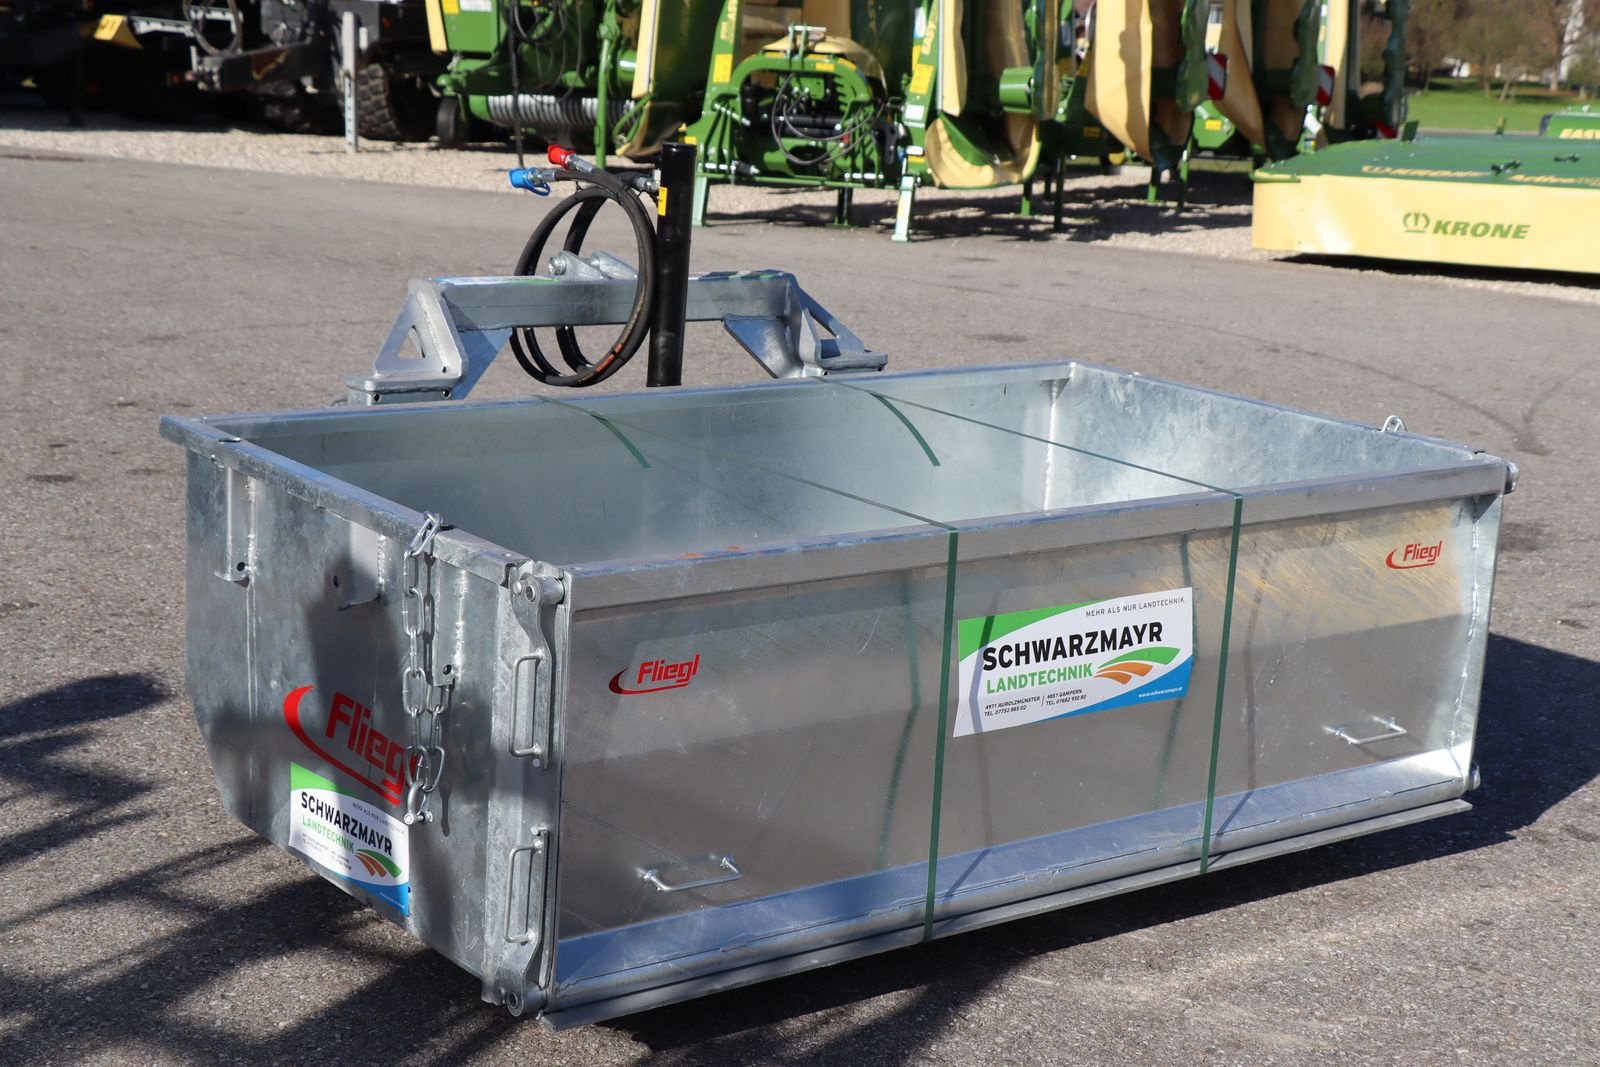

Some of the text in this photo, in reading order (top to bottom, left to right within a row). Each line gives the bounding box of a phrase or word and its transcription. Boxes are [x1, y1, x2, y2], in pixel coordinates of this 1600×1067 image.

[1432, 219, 1530, 240] KRONE
[1403, 540, 1443, 563] Fliegl
[1085, 609, 1105, 617] MEHR
[1107, 606, 1121, 614] ALS
[1122, 604, 1137, 612] NUR
[982, 621, 1163, 671] SCHWARZMAYR
[637, 654, 700, 685] Fliegl
[986, 662, 1093, 694] LANDTECHNIK
[301, 791, 393, 857] SCHWARZMAYR
[301, 814, 355, 855] LANDTECHNIK
